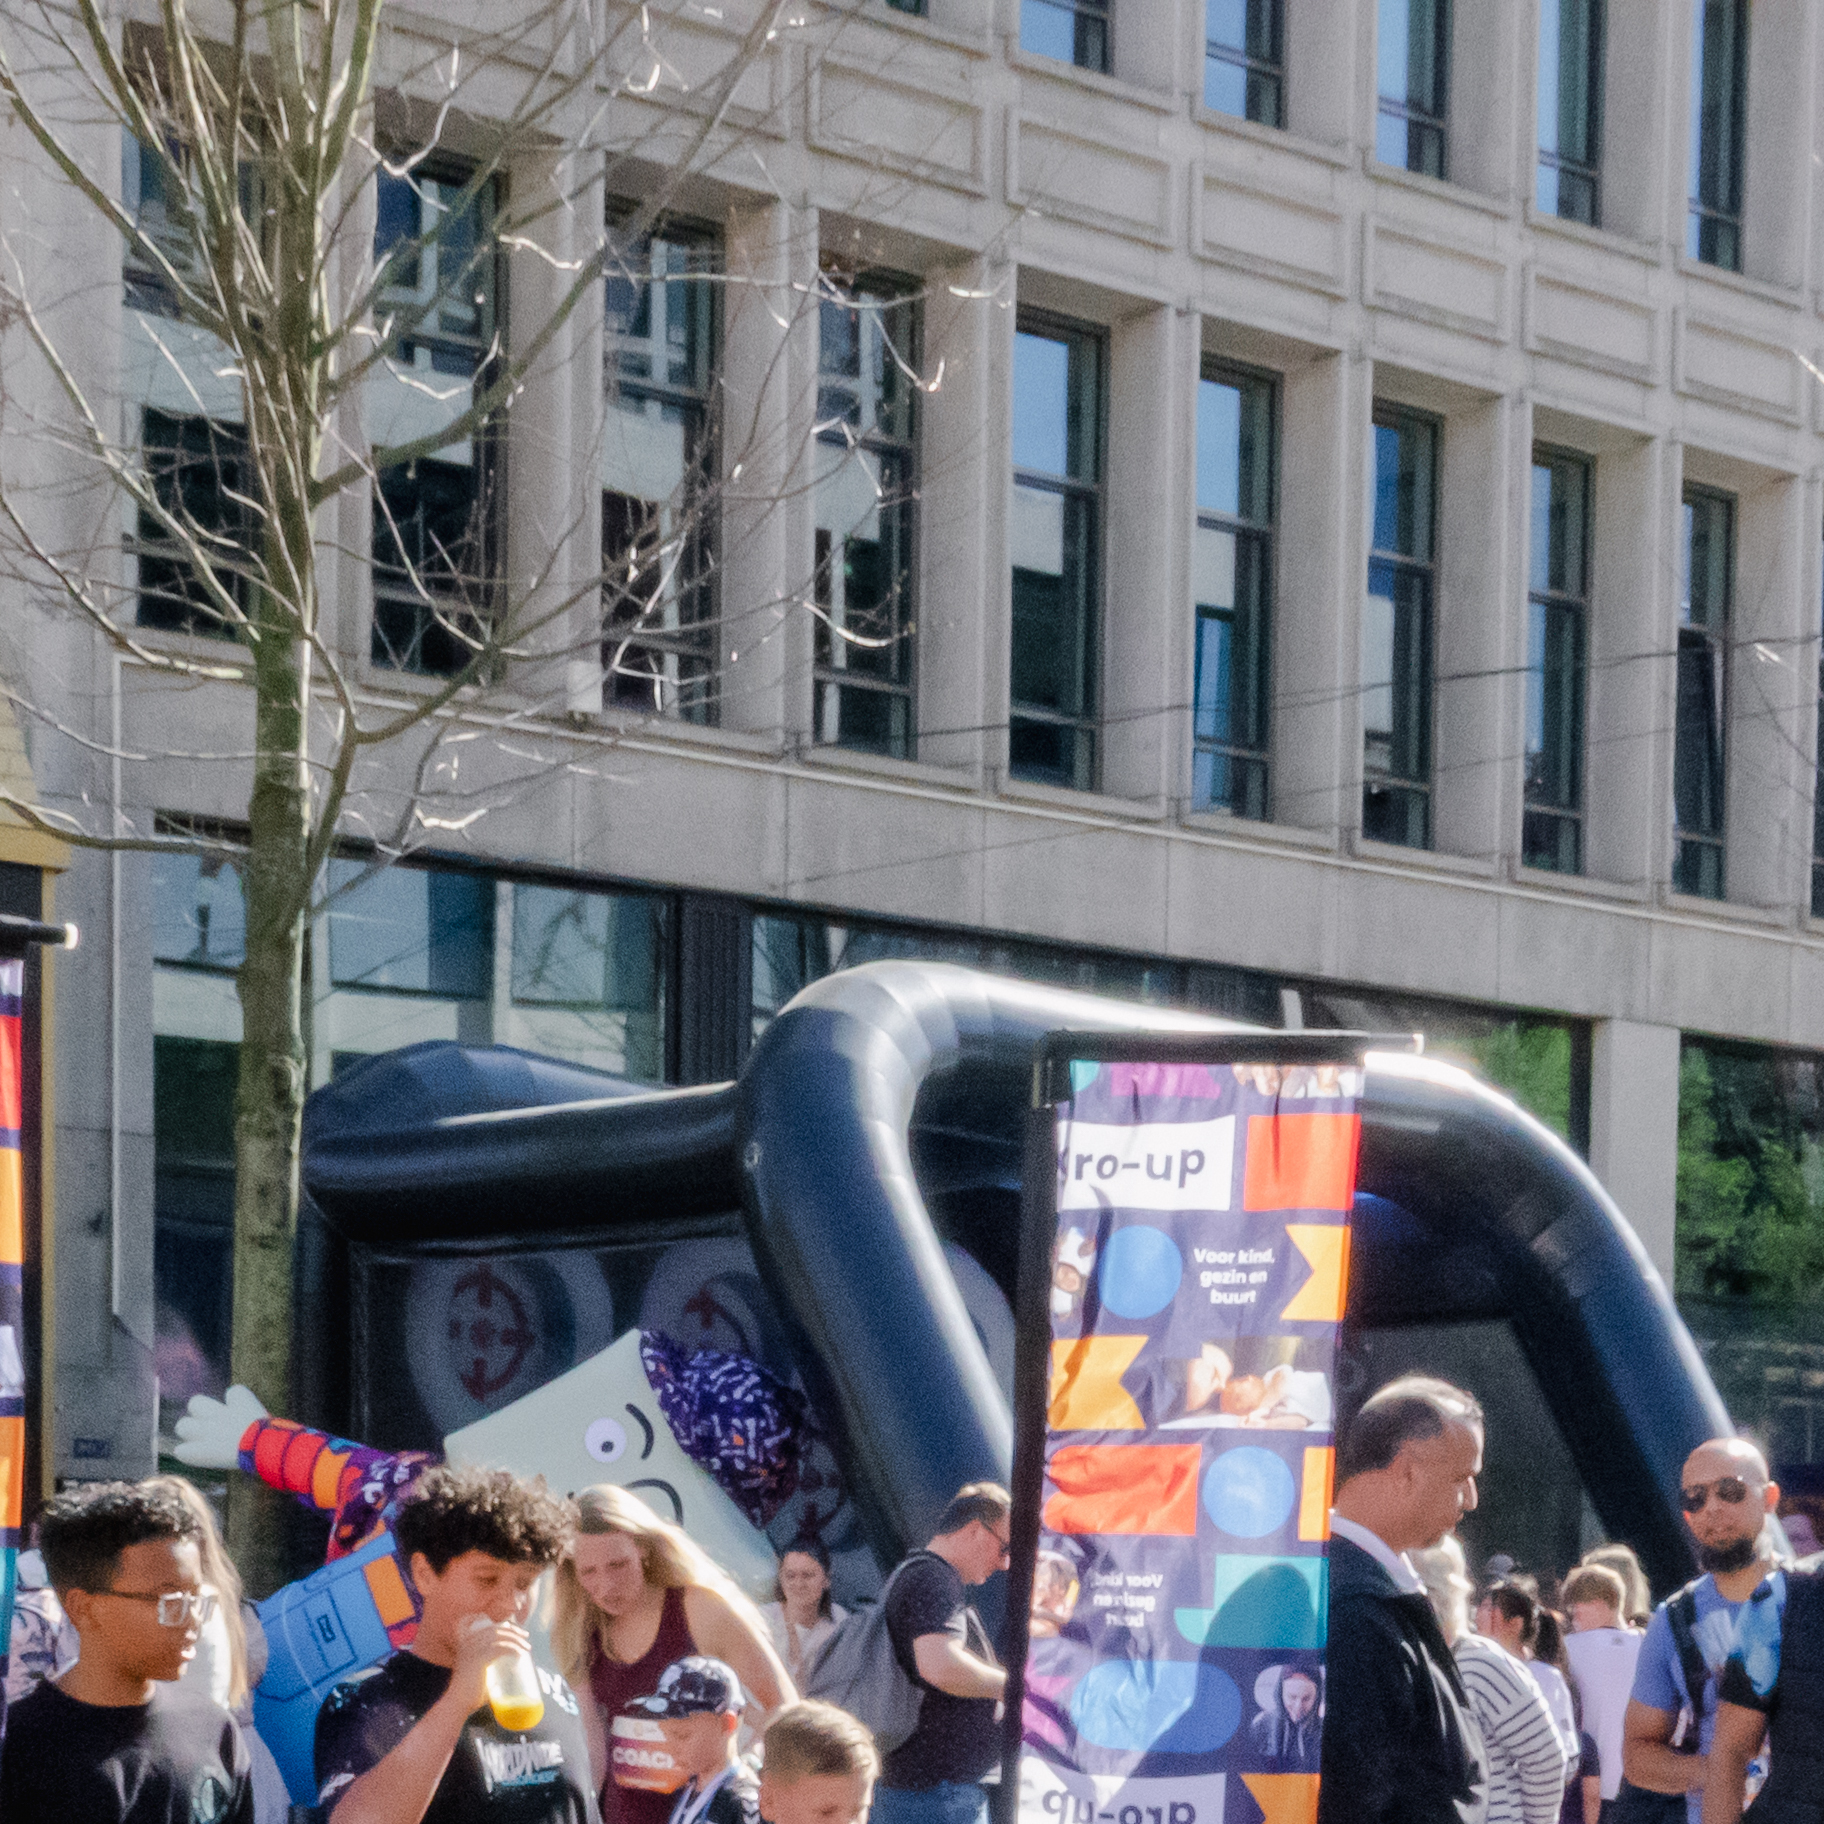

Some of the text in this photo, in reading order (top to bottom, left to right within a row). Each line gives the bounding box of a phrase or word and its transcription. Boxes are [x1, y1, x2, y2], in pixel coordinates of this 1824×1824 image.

[1066, 1148, 1206, 1189] ro-up
[1193, 1248, 1236, 1264] Voor
[1199, 1269, 1268, 1287] gezin en
[1209, 1288, 1257, 1305] buurt
